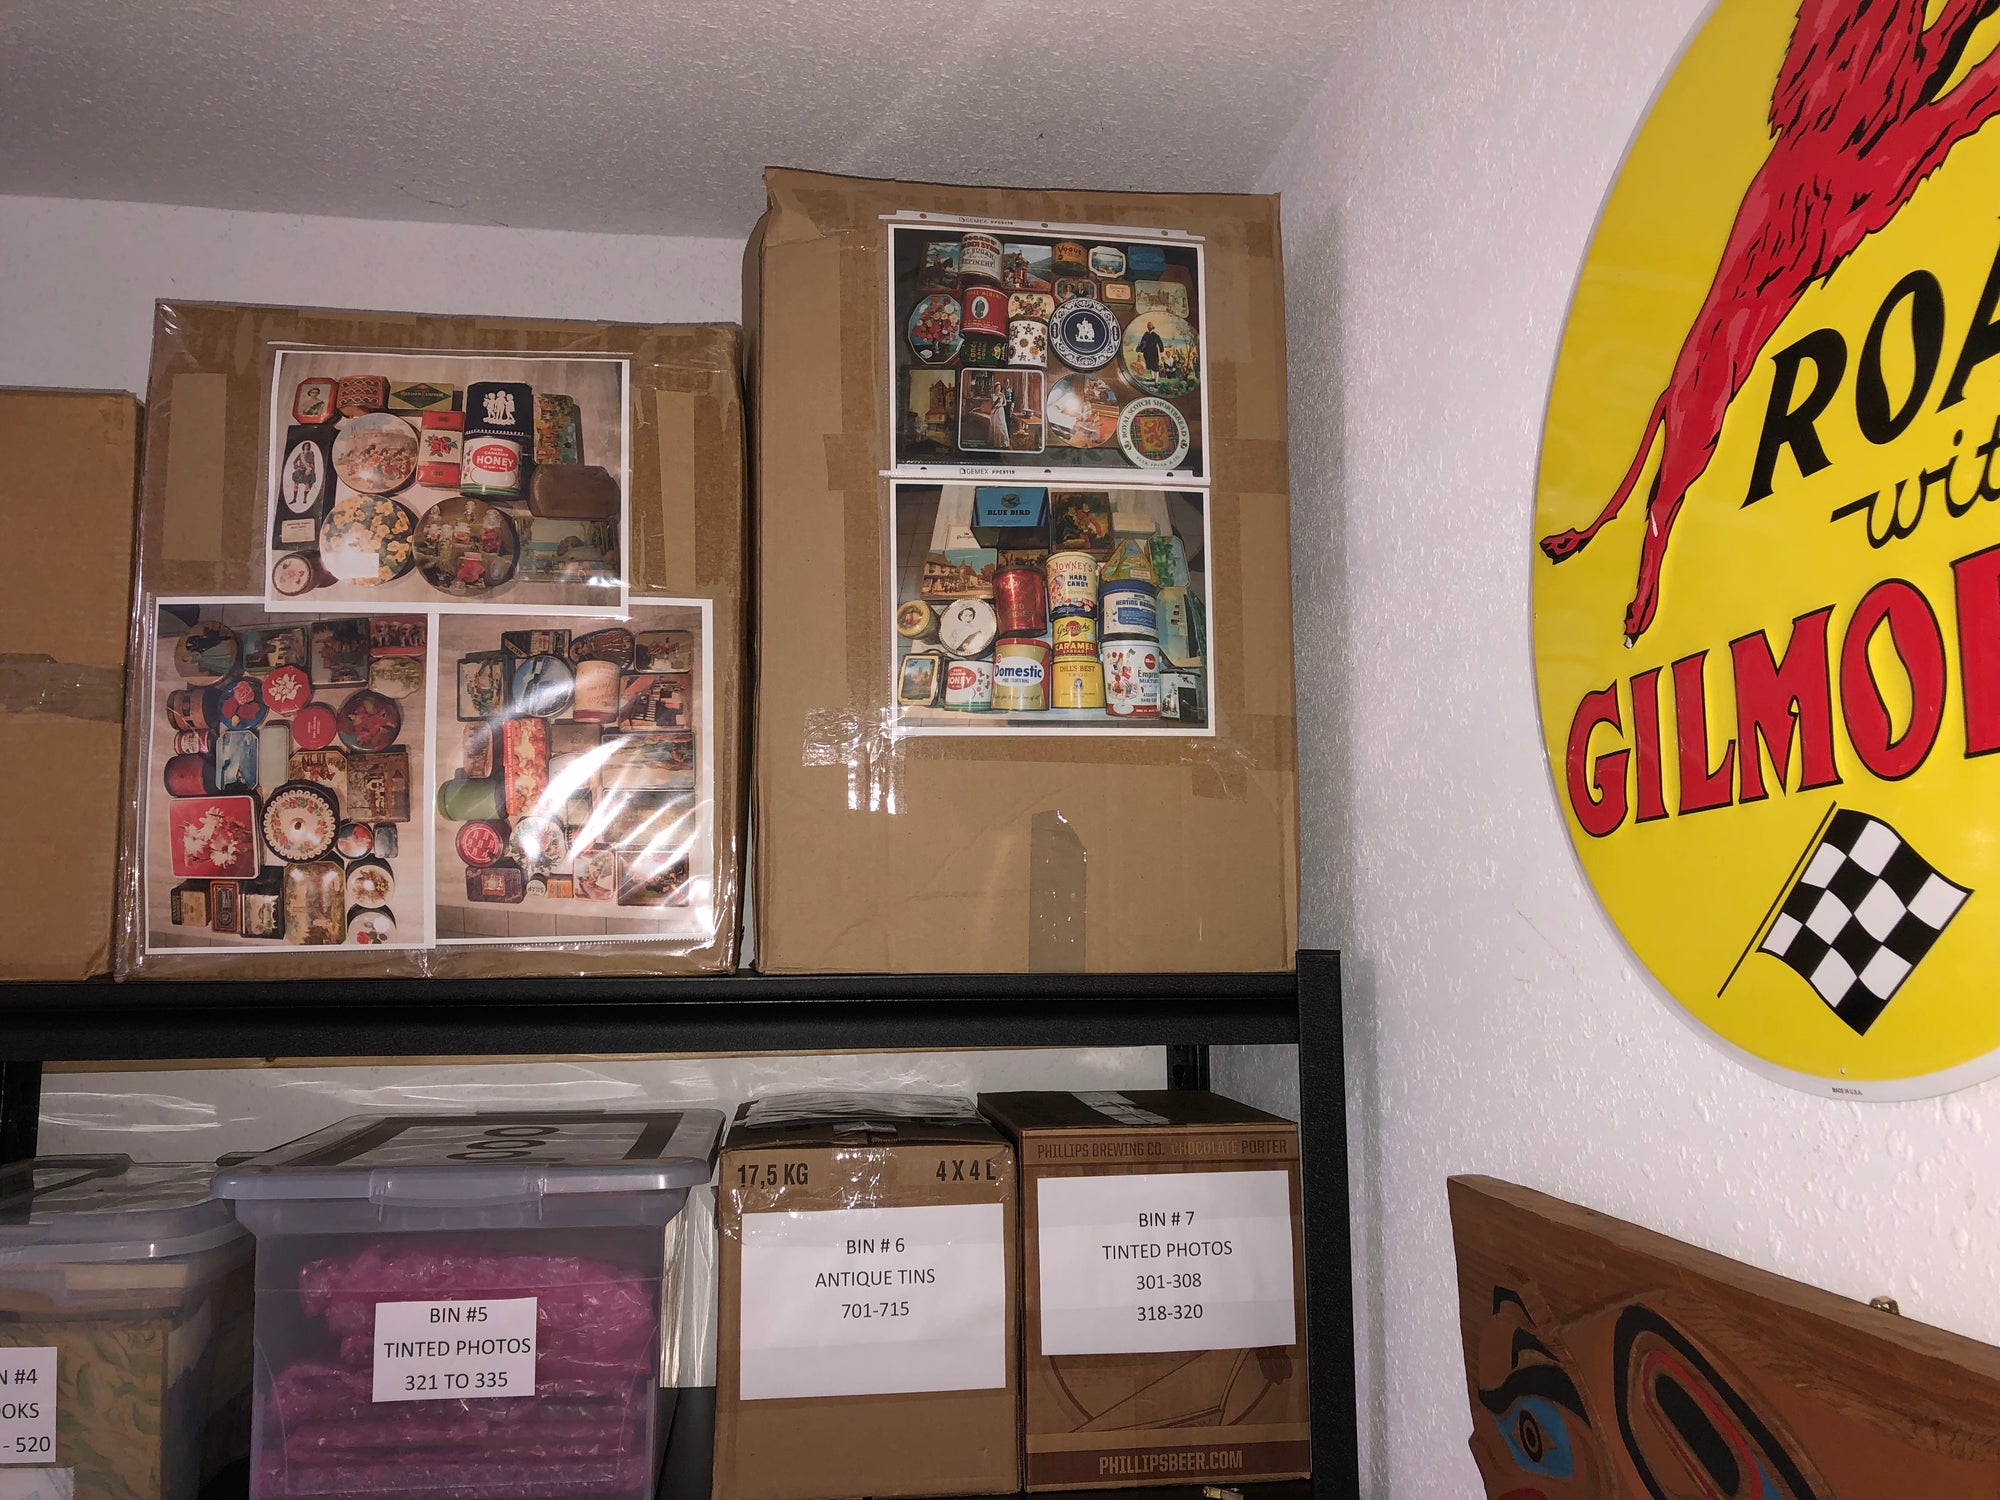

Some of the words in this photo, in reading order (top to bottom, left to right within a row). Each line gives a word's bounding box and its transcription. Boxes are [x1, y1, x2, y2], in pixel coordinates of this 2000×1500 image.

[1121, 417, 1130, 439] ROYAL
[1128, 399, 1151, 414] SCOTCH
[1152, 399, 1188, 437] SHORTBREAD
[476, 455, 514, 468] HONEY
[1069, 574, 1087, 582] HARD
[1055, 642, 1094, 651] CARAMEL
[994, 664, 1043, 679] Domestic
[1079, 665, 1096, 673] BEST
[1037, 1143, 1089, 1158] PHILLIPS
[1092, 1142, 1144, 1157] BREWING
[1147, 1141, 1165, 1156] CO.
[1171, 1140, 1238, 1155] CHOCOLATE
[1241, 1139, 1287, 1154] PORTER
[737, 1164, 778, 1189] 17,5
[783, 1162, 809, 1185] KG
[1139, 1212, 1166, 1227] BIN
[1185, 1211, 1195, 1226] 7
[846, 1239, 875, 1255] BIN
[895, 1237, 905, 1253] 6
[1101, 1243, 1161, 1260] TINTED
[1166, 1240, 1233, 1257] PHOTOS
[815, 1270, 893, 1288] ANTIQUE
[897, 1268, 936, 1284] TINS
[1136, 1272, 1202, 1290] 301-308
[430, 1307, 460, 1323] BIN
[466, 1306, 488, 1322] #5
[841, 1301, 910, 1319] 701-715
[1137, 1303, 1203, 1321] 318-320
[383, 1341, 450, 1358] TINTED
[456, 1338, 531, 1356] PHOTOS
[14, 1369, 38, 1385] #4
[404, 1374, 438, 1391] 321
[444, 1373, 469, 1390] TO
[475, 1371, 508, 1388] 335
[0, 1403, 40, 1419] OKS
[16, 1436, 51, 1453] 520
[1099, 1450, 1243, 1475] PHILLIPSBEER.COM
